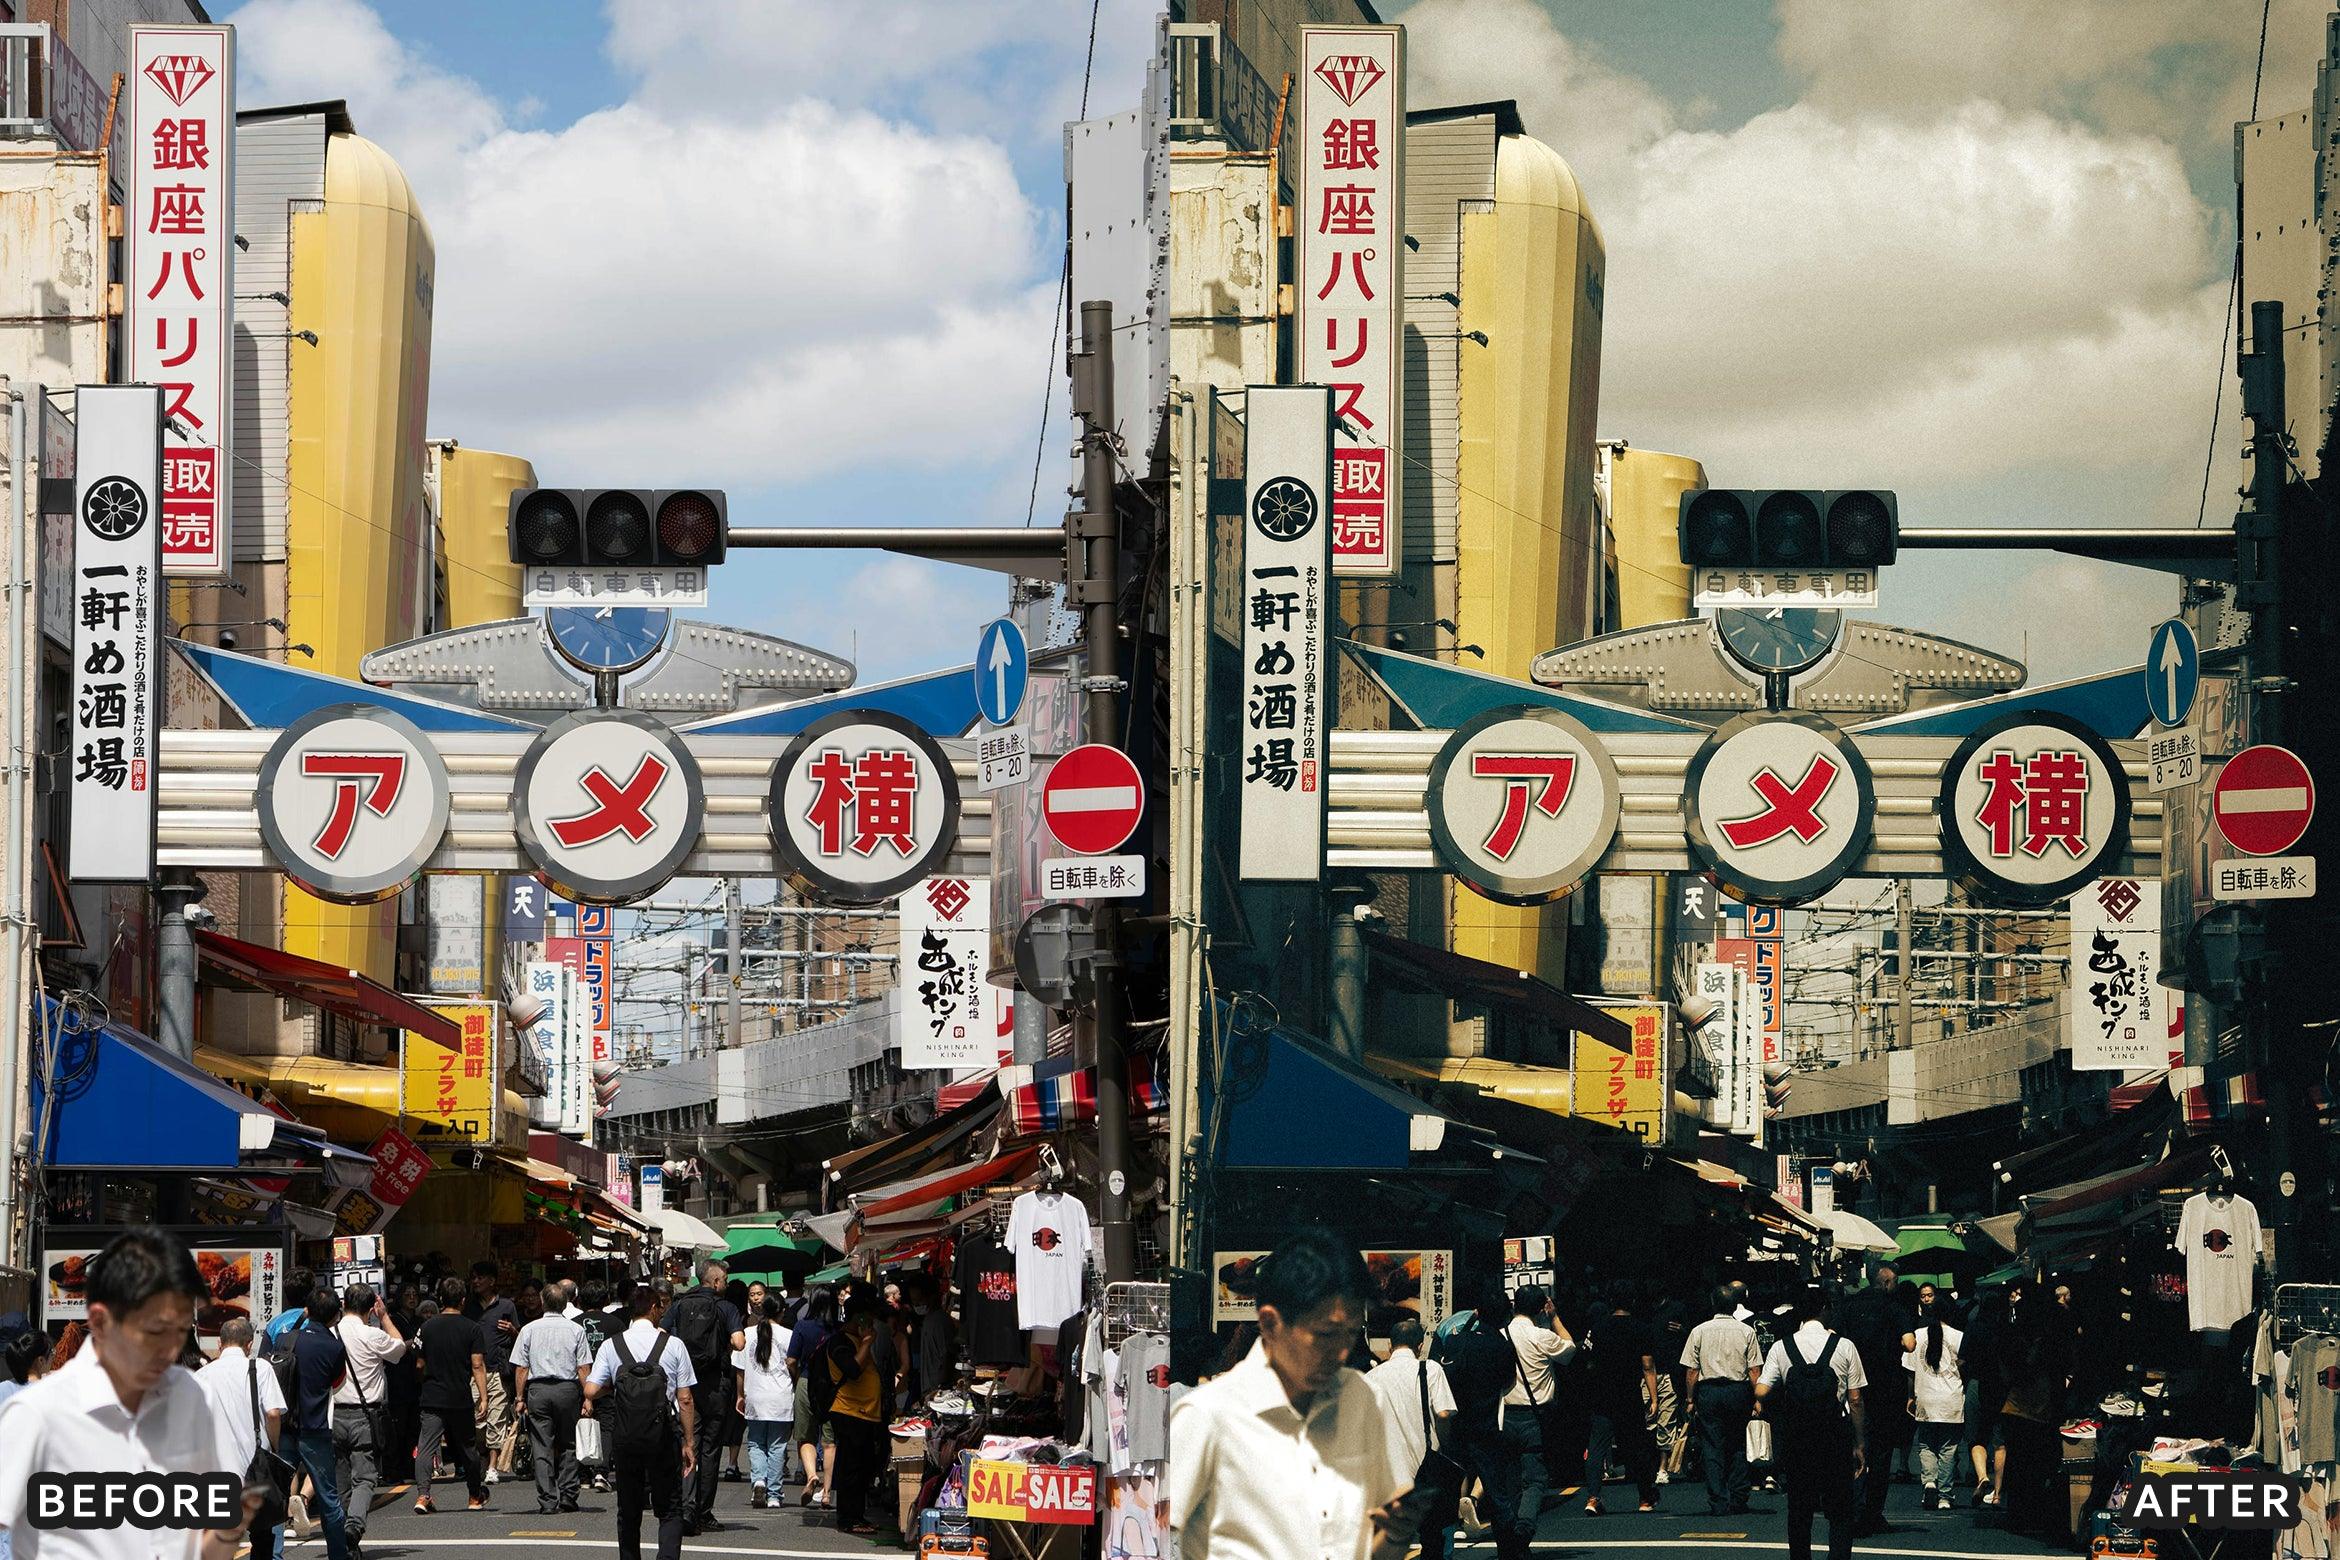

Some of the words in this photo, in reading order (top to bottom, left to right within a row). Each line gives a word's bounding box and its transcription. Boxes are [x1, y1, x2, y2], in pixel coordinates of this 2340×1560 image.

[148, 118, 209, 430] 銀座パリス
[1318, 118, 1379, 430] 銀座パリス
[536, 570, 697, 598] 自転車専用
[1707, 571, 1868, 599] 自転車専用
[75, 565, 130, 790] 一軒め酒場
[133, 565, 148, 758] おやじが喜ぶこだわりの酒と肴だけの店
[1245, 566, 1300, 791] 一軒め酒場
[1303, 566, 1318, 759] おやじが喜ぶこだわりの酒と肴だけの店
[981, 733, 1025, 761] 自転車を除く
[2152, 734, 2196, 762] 自転車を除く
[1050, 866, 1136, 890] 自転車を除く
[2221, 867, 2307, 891] 自転車を除く
[967, 949, 980, 1020] ホルモン酒場
[2138, 951, 2151, 1022] ホルモン酒場
[464, 1014, 485, 1079] 御徒町
[1634, 1016, 1655, 1081] 御徒町
[436, 1052, 458, 1118] プラザ
[1606, 1054, 1628, 1120] プラザ
[448, 1118, 479, 1136] 入口
[378, 1142, 421, 1183] 免税
[386, 1172, 409, 1195] Free
[986, 1292, 1011, 1301] TOKYO
[1029, 1475, 1092, 1511] SALE
